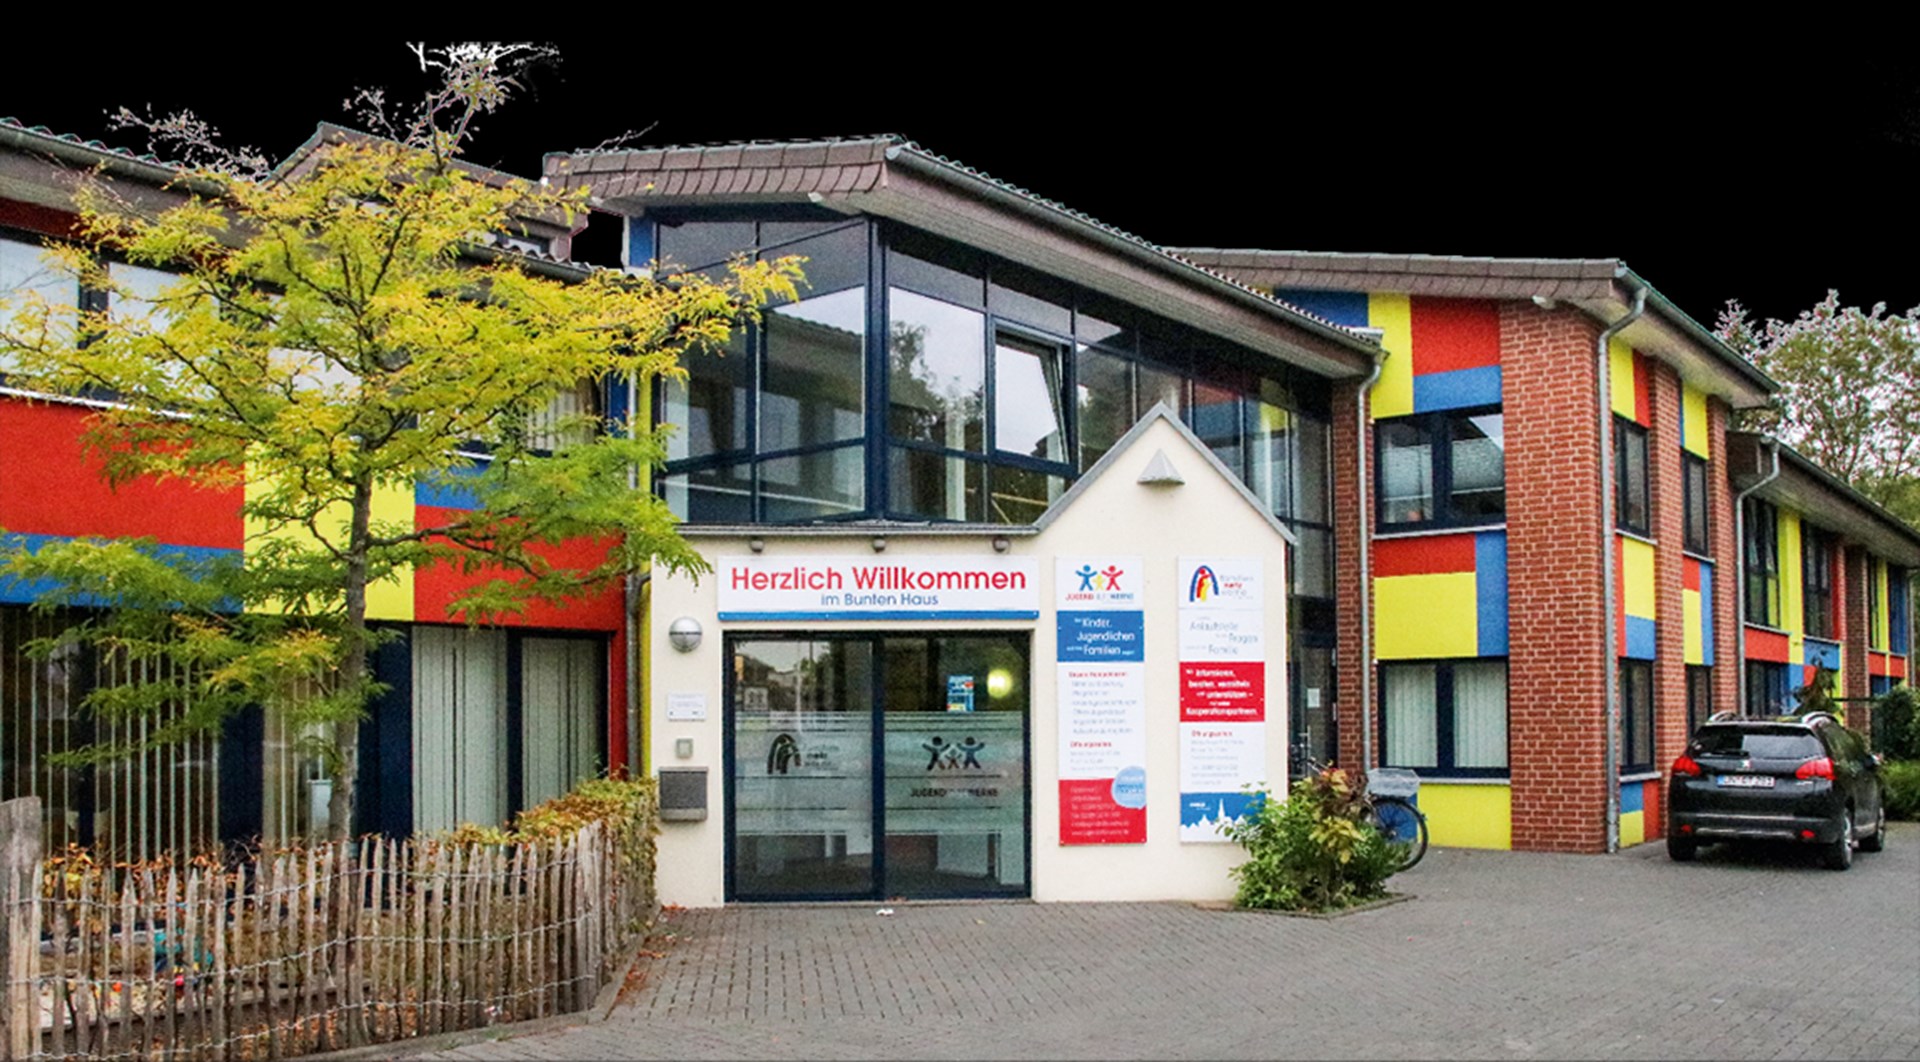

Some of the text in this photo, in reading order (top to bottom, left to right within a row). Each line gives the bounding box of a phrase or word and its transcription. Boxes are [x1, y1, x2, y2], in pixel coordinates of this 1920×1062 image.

[731, 566, 1027, 590] Herzlich Willkommen
[821, 593, 939, 606] im Bunten Haus
[1077, 631, 1135, 643] Jugendlichen
[1083, 645, 1121, 655] Familien
